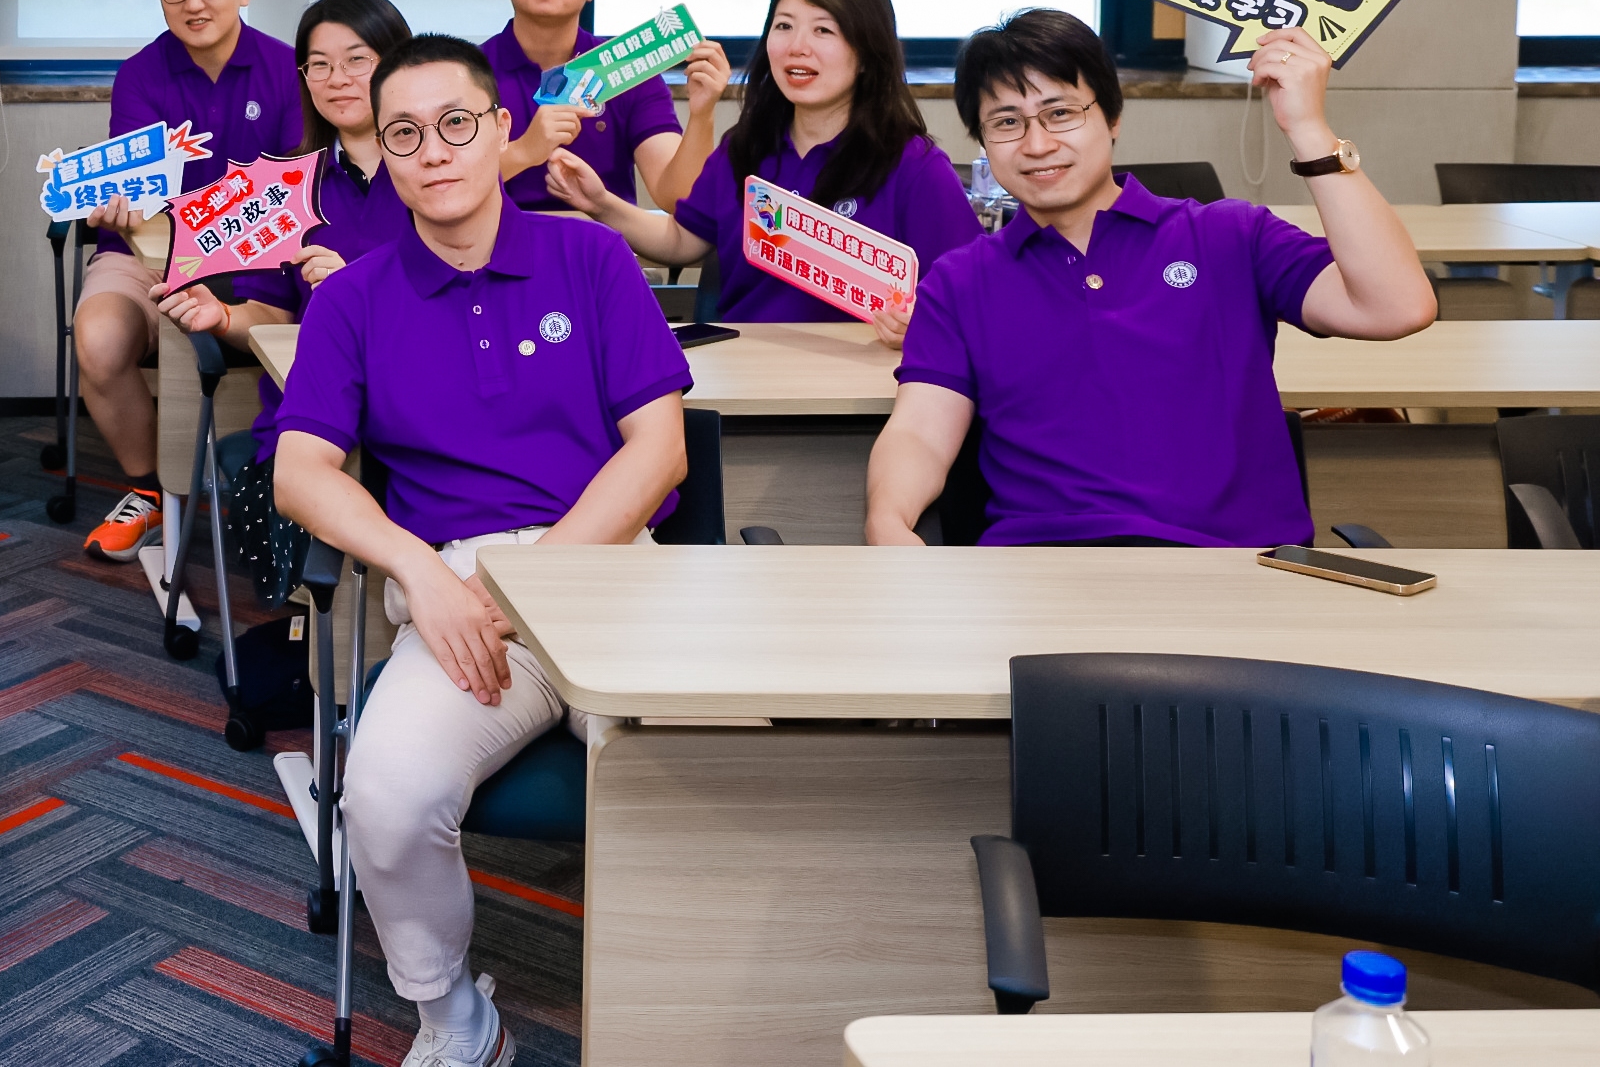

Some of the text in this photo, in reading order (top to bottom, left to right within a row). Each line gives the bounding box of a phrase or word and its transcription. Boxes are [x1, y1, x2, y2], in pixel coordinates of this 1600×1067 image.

[598, 27, 656, 67] 价值投资
[607, 30, 700, 89] 投资我们的情谊
[57, 134, 153, 183] 管理思想
[74, 173, 169, 210] 终身学习
[183, 176, 254, 229] 让世界
[197, 185, 289, 255] 因为故事
[234, 212, 300, 263] 更温柔
[786, 206, 907, 281] 用理性思维看世界
[759, 240, 886, 313] 用温度改变世界
